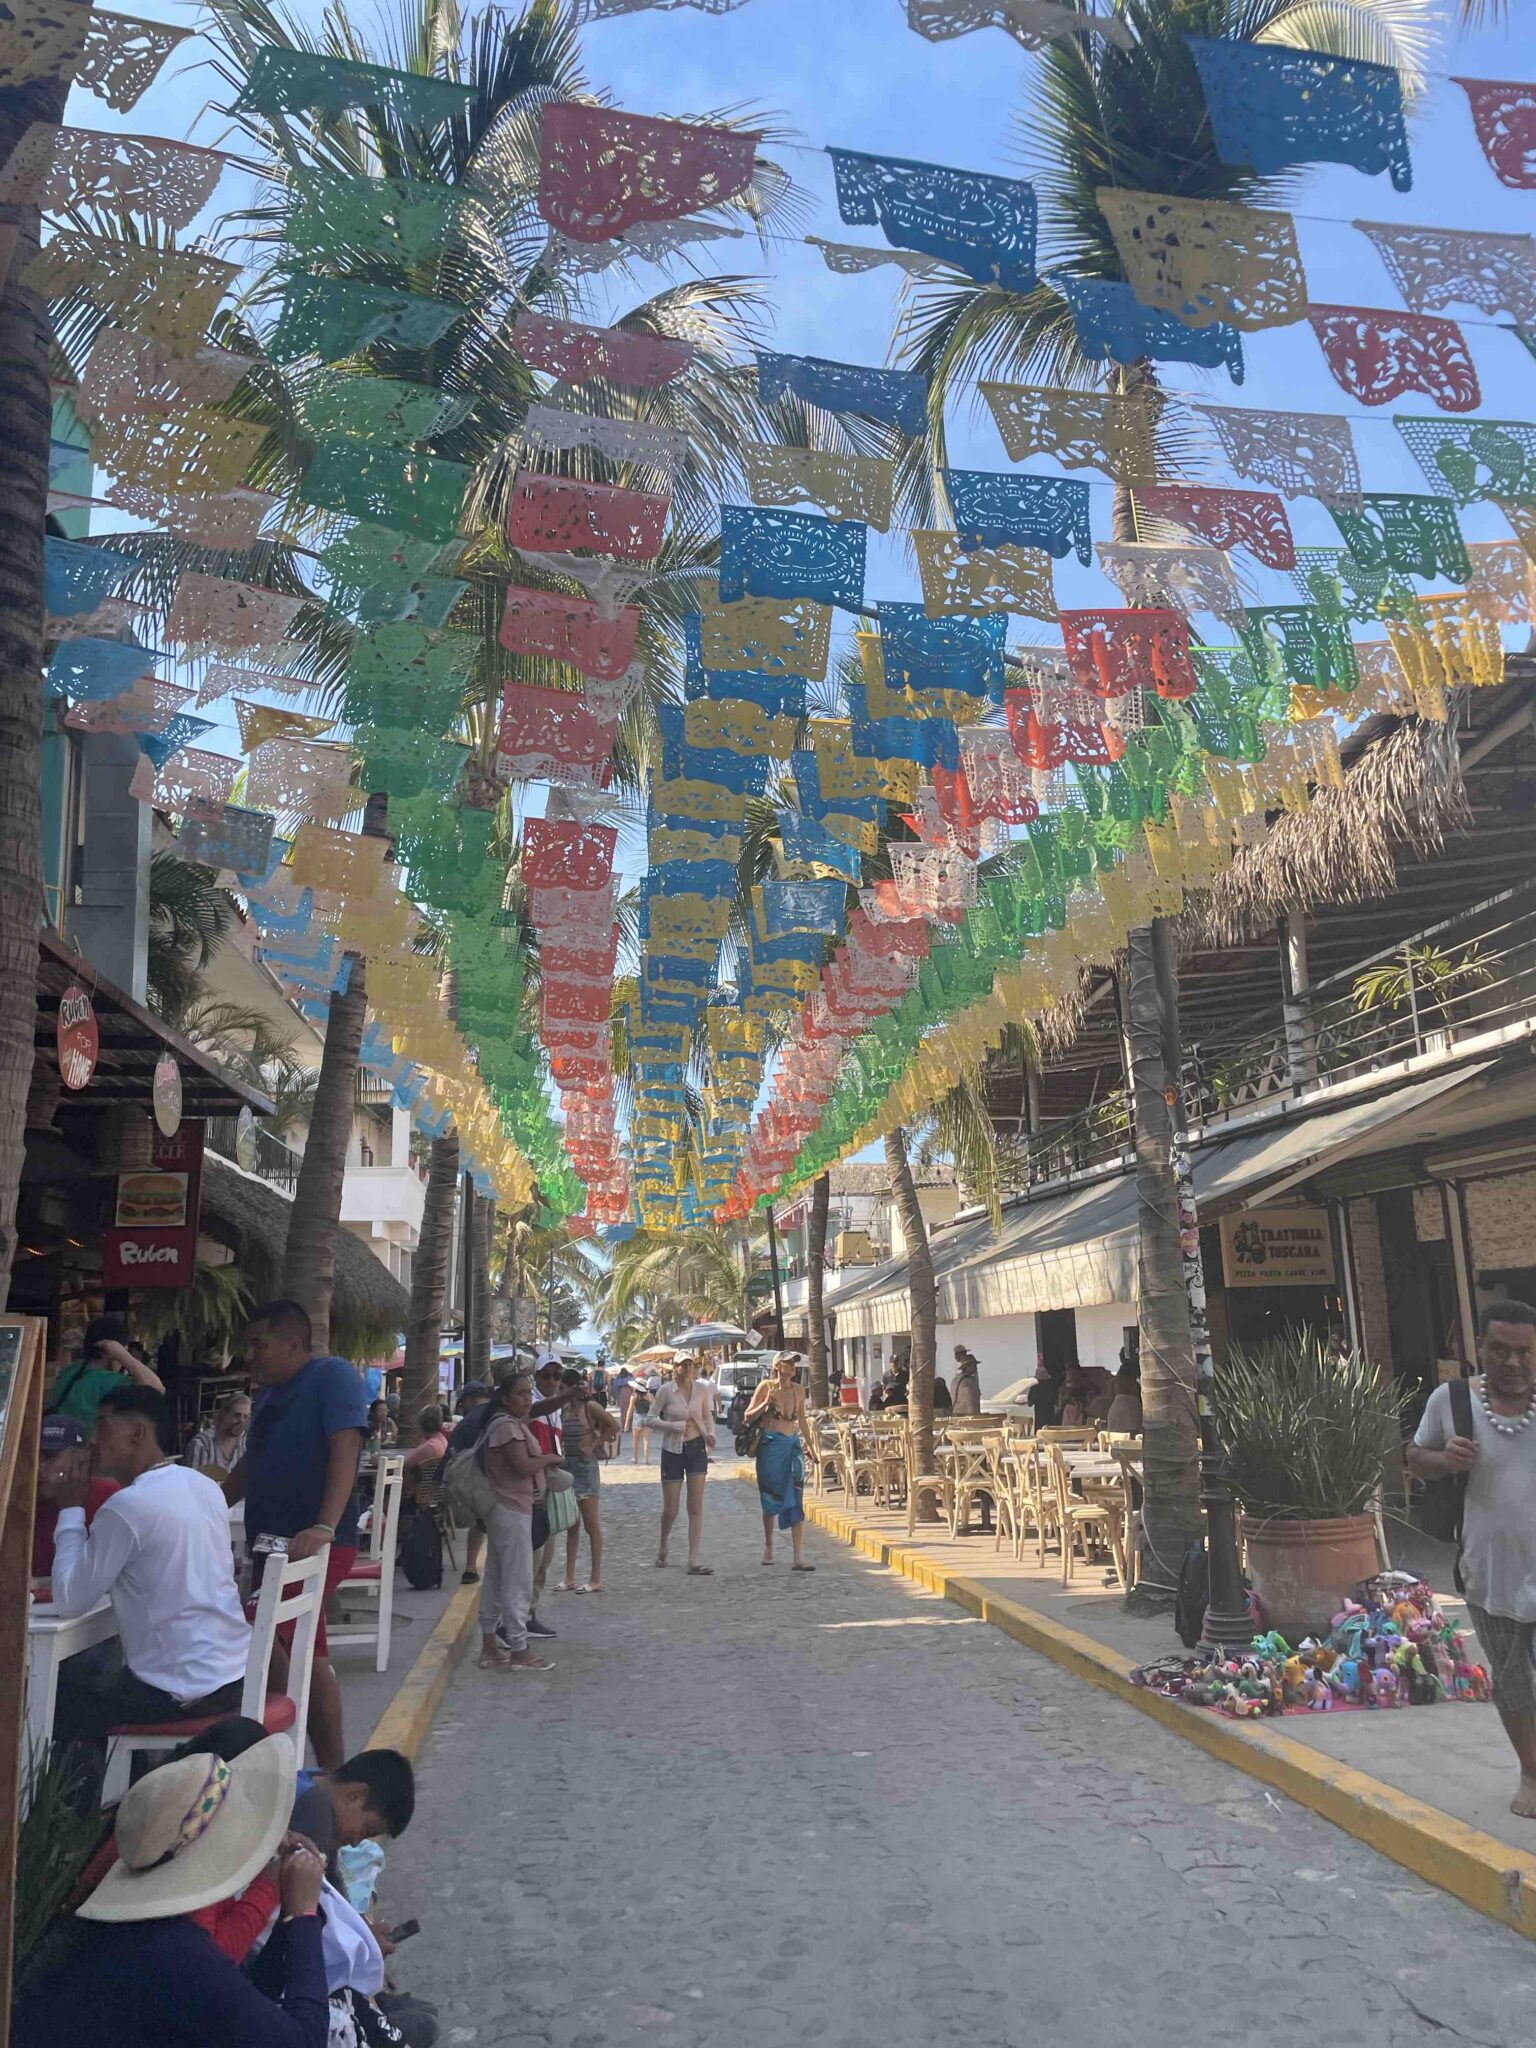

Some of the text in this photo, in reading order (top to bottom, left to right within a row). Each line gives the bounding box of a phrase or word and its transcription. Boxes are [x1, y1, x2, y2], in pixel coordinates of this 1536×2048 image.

[1260, 1228, 1324, 1242] TRATTORIA
[119, 1241, 179, 1265] Ruben
[1235, 1270, 1256, 1278] PIZZA
